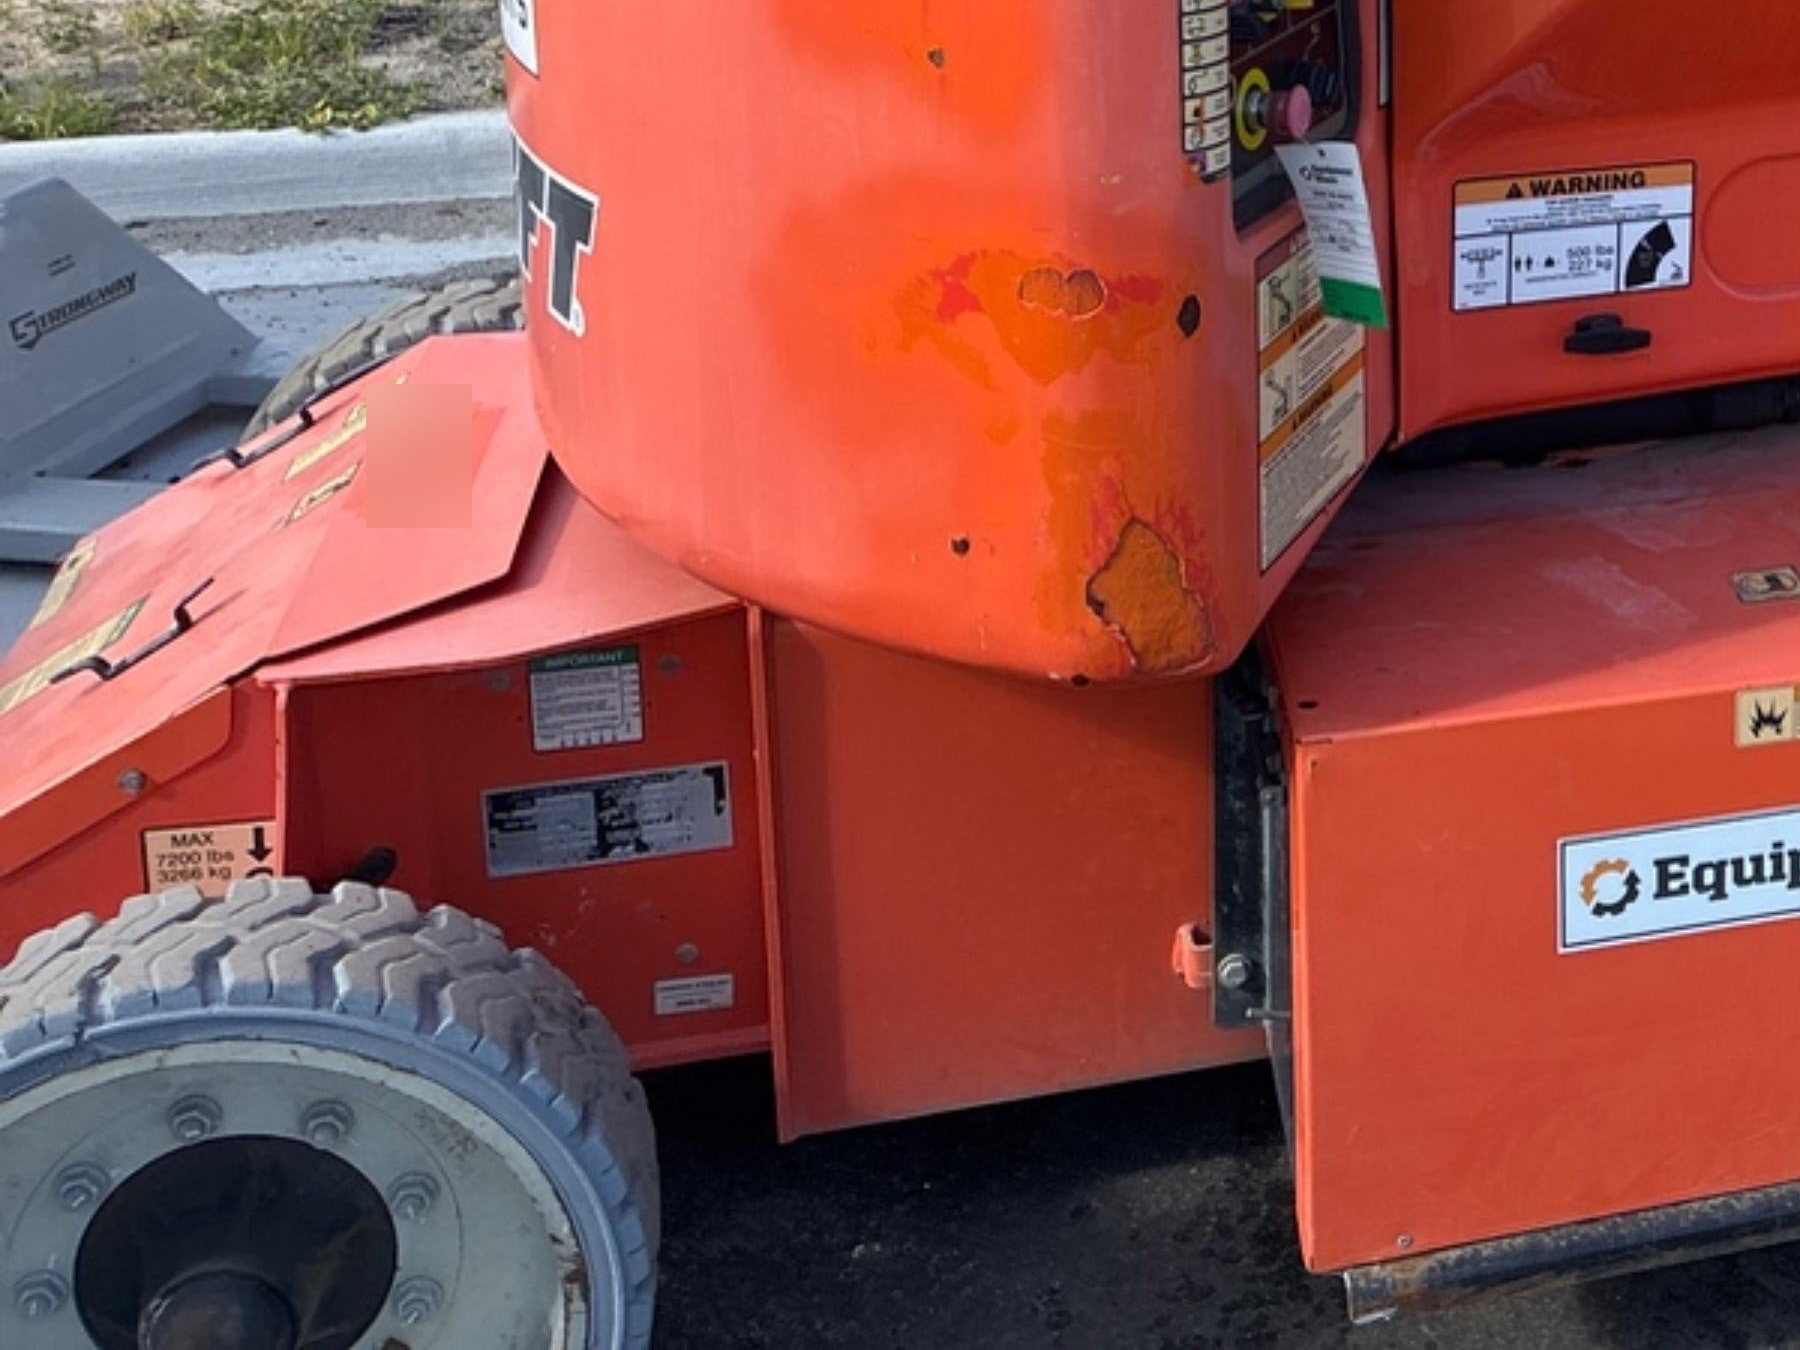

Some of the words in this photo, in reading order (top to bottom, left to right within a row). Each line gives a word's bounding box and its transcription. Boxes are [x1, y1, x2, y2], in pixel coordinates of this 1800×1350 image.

[1529, 170, 1646, 198] WARNING
[510, 125, 600, 338] FT
[171, 831, 214, 847] MAX
[156, 851, 201, 867] 7200
[207, 849, 235, 863] lbs
[208, 866, 232, 881] kg
